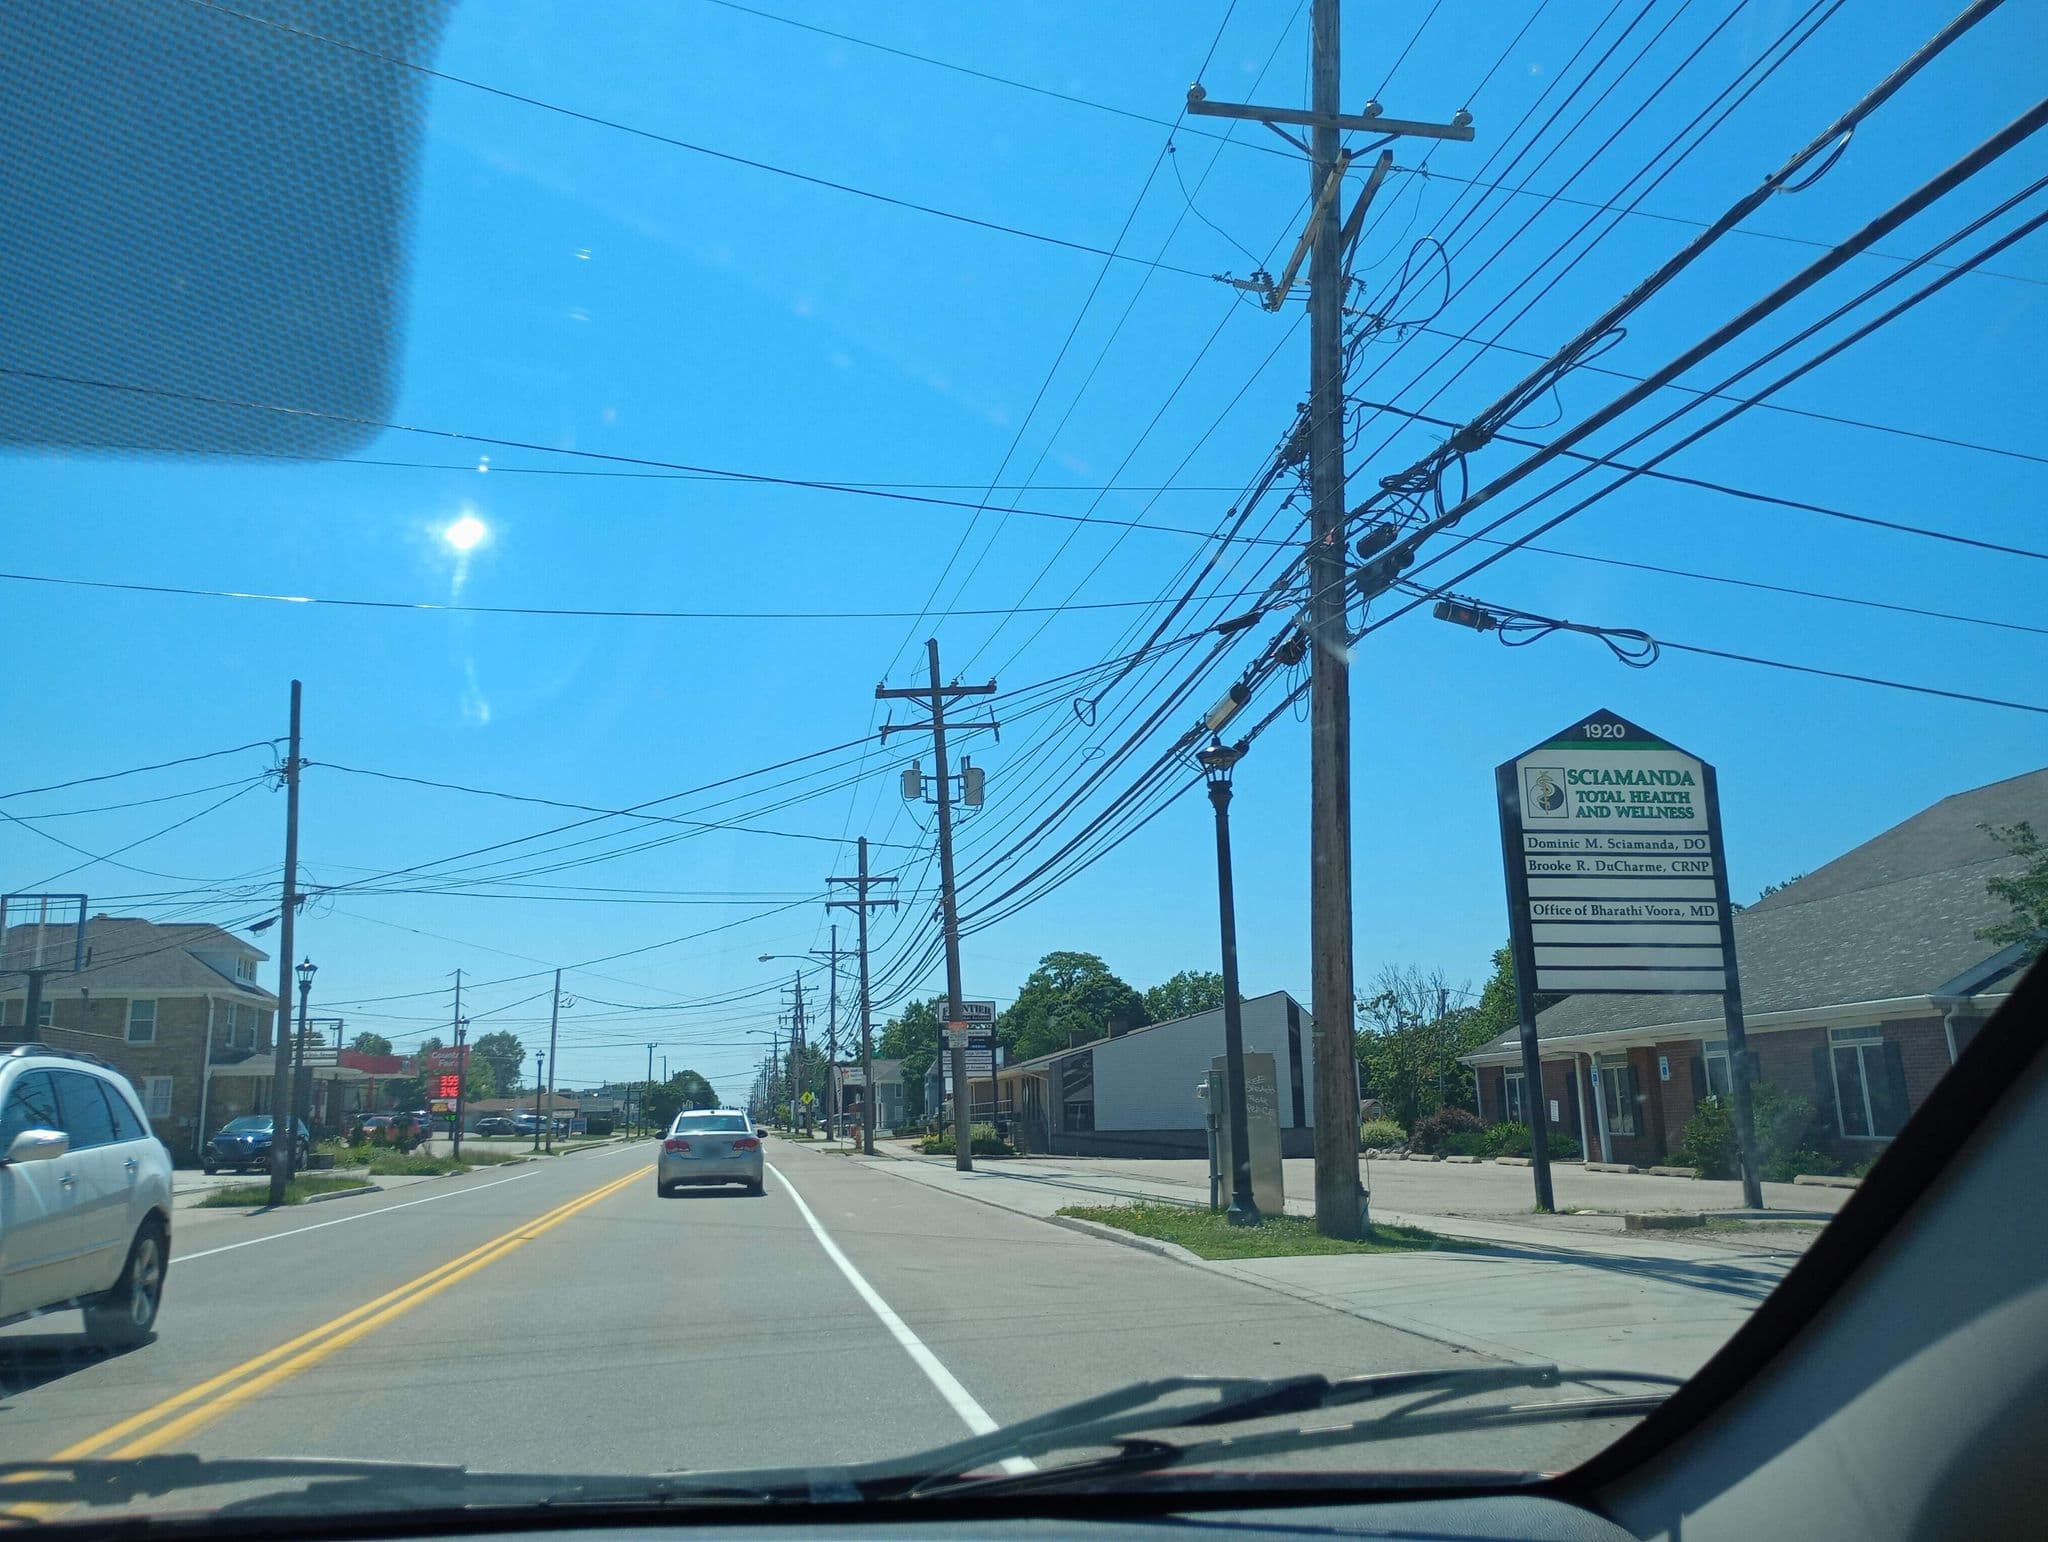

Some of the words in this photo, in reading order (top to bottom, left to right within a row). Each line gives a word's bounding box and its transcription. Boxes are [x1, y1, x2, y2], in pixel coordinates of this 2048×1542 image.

[1583, 724, 1626, 738] 1920
[1567, 769, 1695, 786] SCIAMANDA
[1576, 791, 1625, 803] TOTAL
[1630, 791, 1691, 803] HEALTH
[1576, 806, 1611, 818] AND
[1615, 806, 1695, 819] WELLNESS
[1528, 837, 1580, 849] Dominic
[1585, 839, 1602, 849] M.
[1608, 839, 1679, 851] Sciamanda,
[1684, 839, 1706, 850] DO
[1529, 860, 1572, 871] Brooke
[1577, 861, 1590, 871] R.
[1596, 861, 1666, 873] DuCharme,
[1671, 861, 1710, 872] CRNP
[1533, 904, 1572, 916] Office
[1575, 904, 1587, 916] of
[1591, 904, 1643, 916] Bharathi
[1646, 905, 1685, 917] Voora,
[1691, 905, 1715, 916] MD
